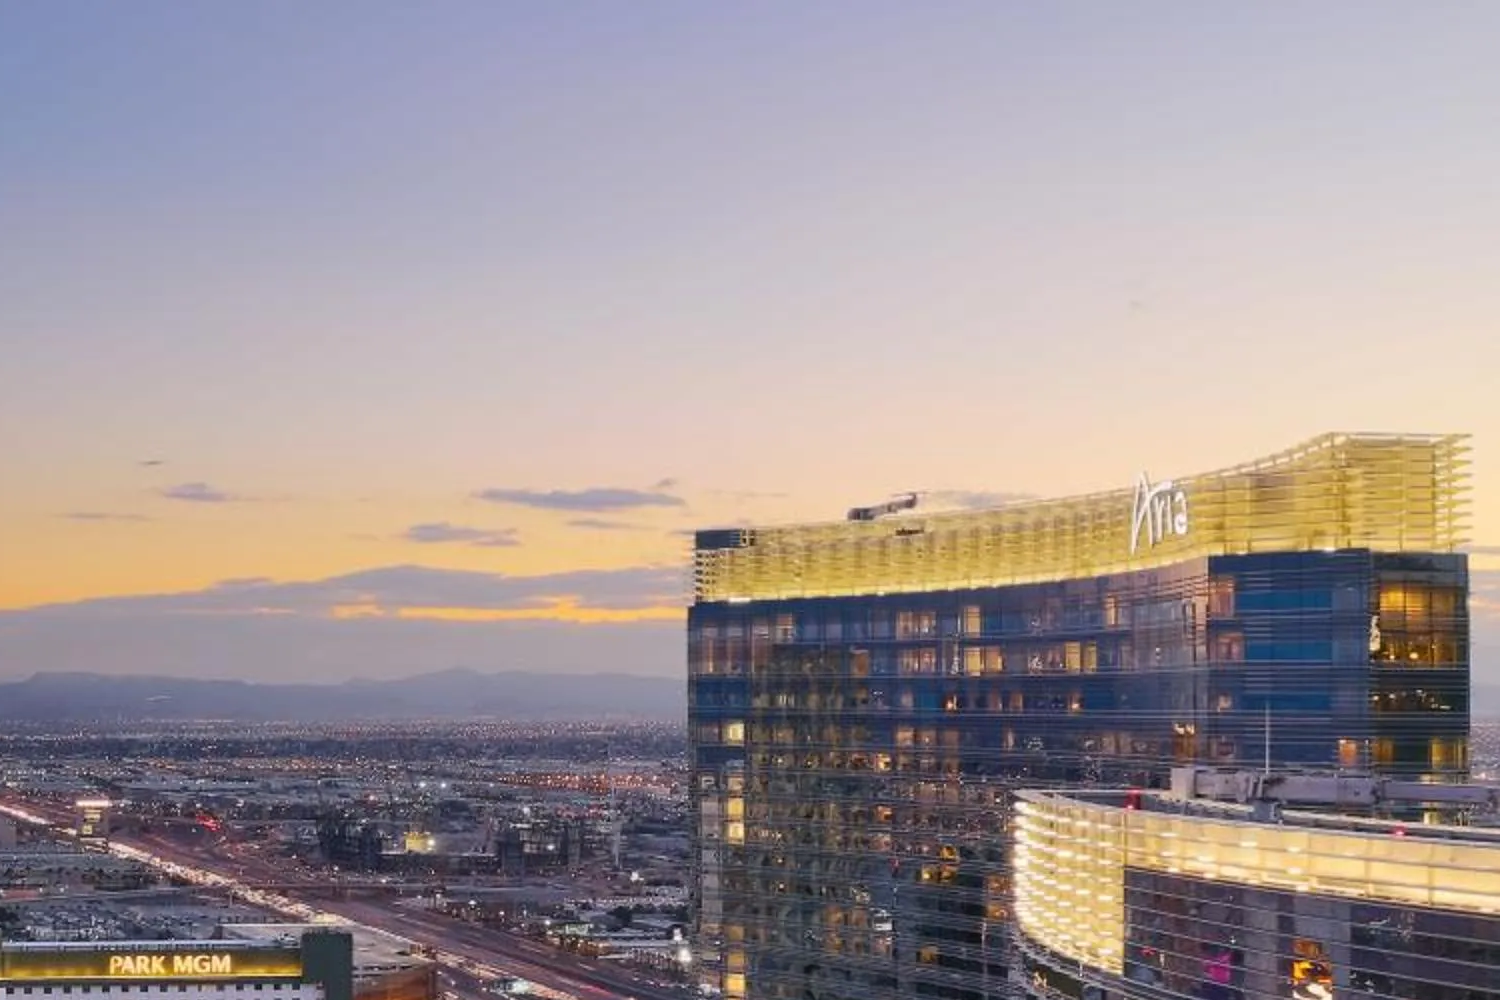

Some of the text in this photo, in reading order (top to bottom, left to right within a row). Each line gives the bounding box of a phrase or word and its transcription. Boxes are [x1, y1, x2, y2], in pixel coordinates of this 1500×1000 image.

[1130, 470, 1188, 556] Aria
[109, 954, 232, 975] PARK MGM
